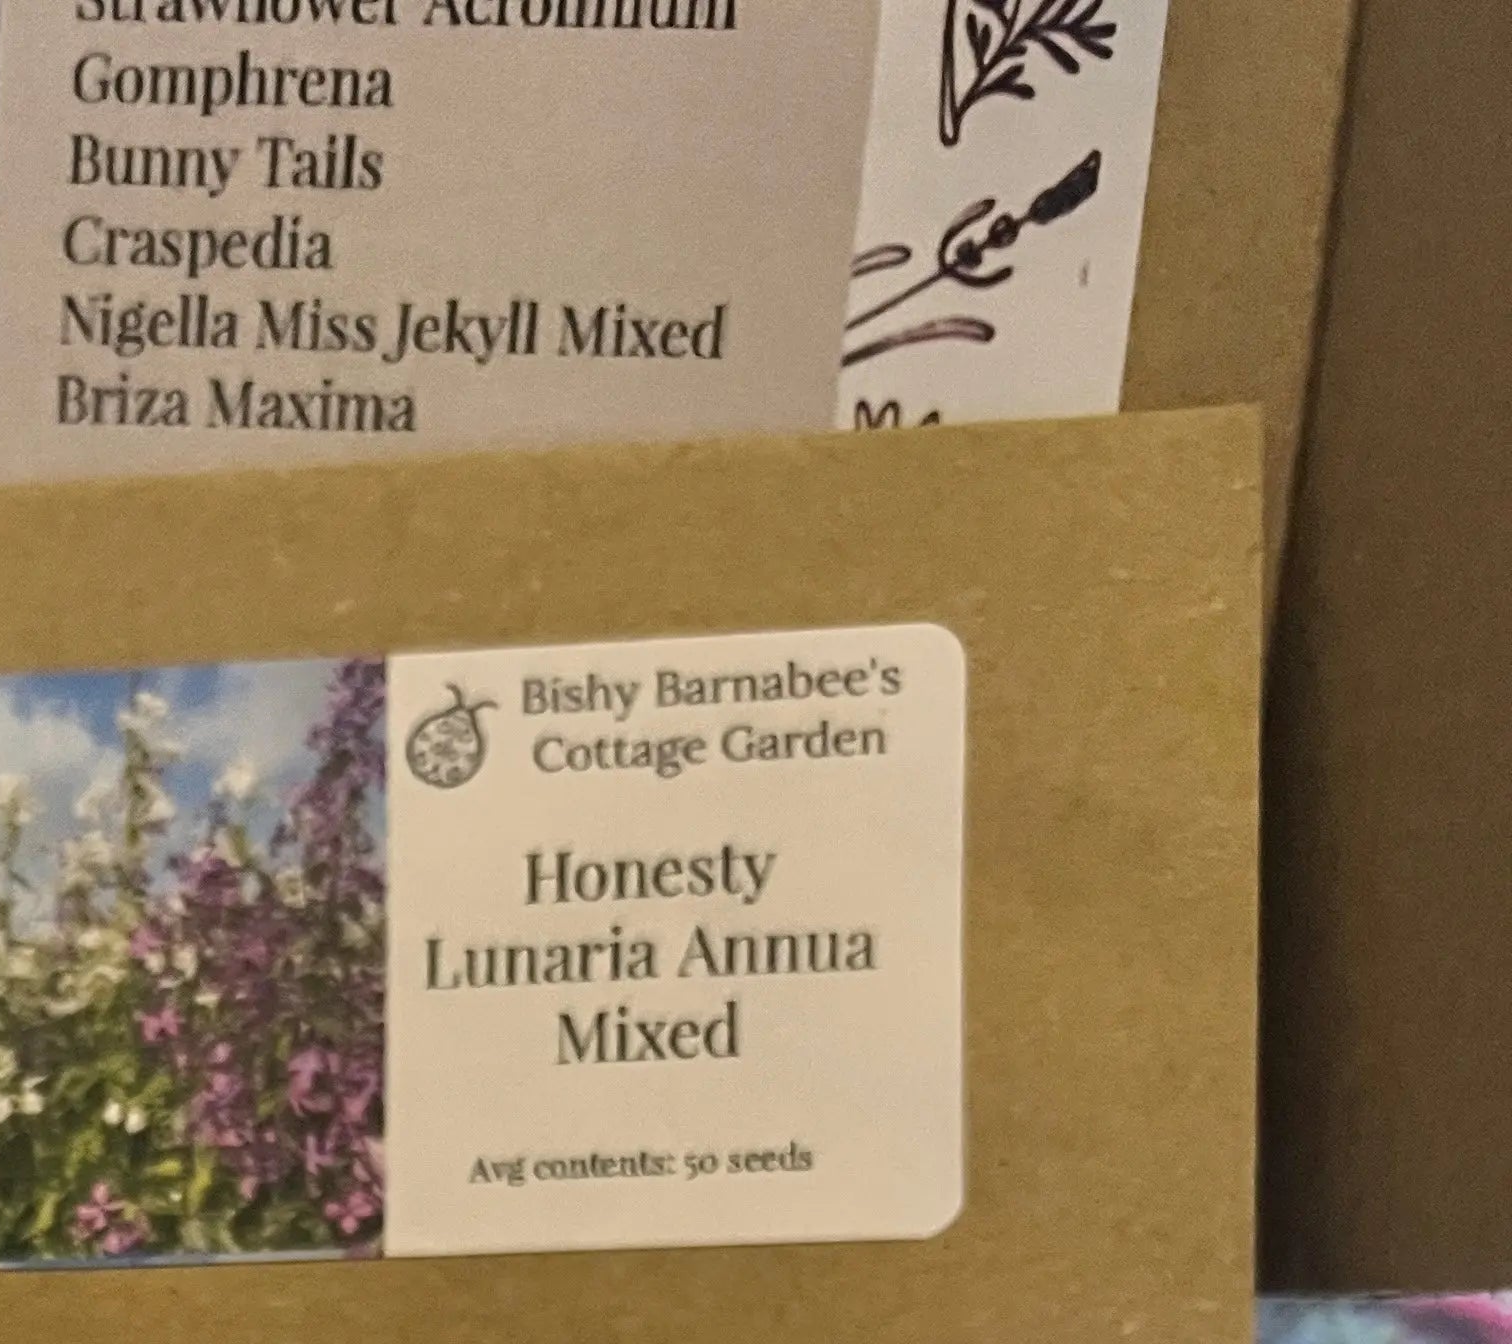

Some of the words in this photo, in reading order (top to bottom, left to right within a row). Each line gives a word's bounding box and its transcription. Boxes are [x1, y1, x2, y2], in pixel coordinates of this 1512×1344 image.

[73, 50, 394, 116] Gomphrena
[68, 134, 240, 199] Bunny
[258, 136, 384, 192] Tails
[62, 214, 334, 277] Craspedia
[58, 294, 238, 355] Nigella
[256, 298, 378, 353] Miss
[382, 297, 538, 364] Jekyll
[558, 303, 726, 361] Mixed
[55, 375, 190, 429] Briza
[204, 378, 416, 434] Maxima
[521, 675, 640, 721] Bishy
[656, 659, 903, 709] Barnabee's
[533, 733, 706, 778] Cottage
[720, 721, 887, 763] Garden
[524, 843, 778, 905] Honesty
[425, 926, 659, 991] Lunaria
[677, 926, 880, 979] Annua
[556, 1000, 741, 1065] Mixed
[469, 1153, 526, 1186] Avg
[533, 1151, 674, 1181] contents:
[683, 1151, 718, 1180] 50
[726, 1141, 813, 1173] seeds
